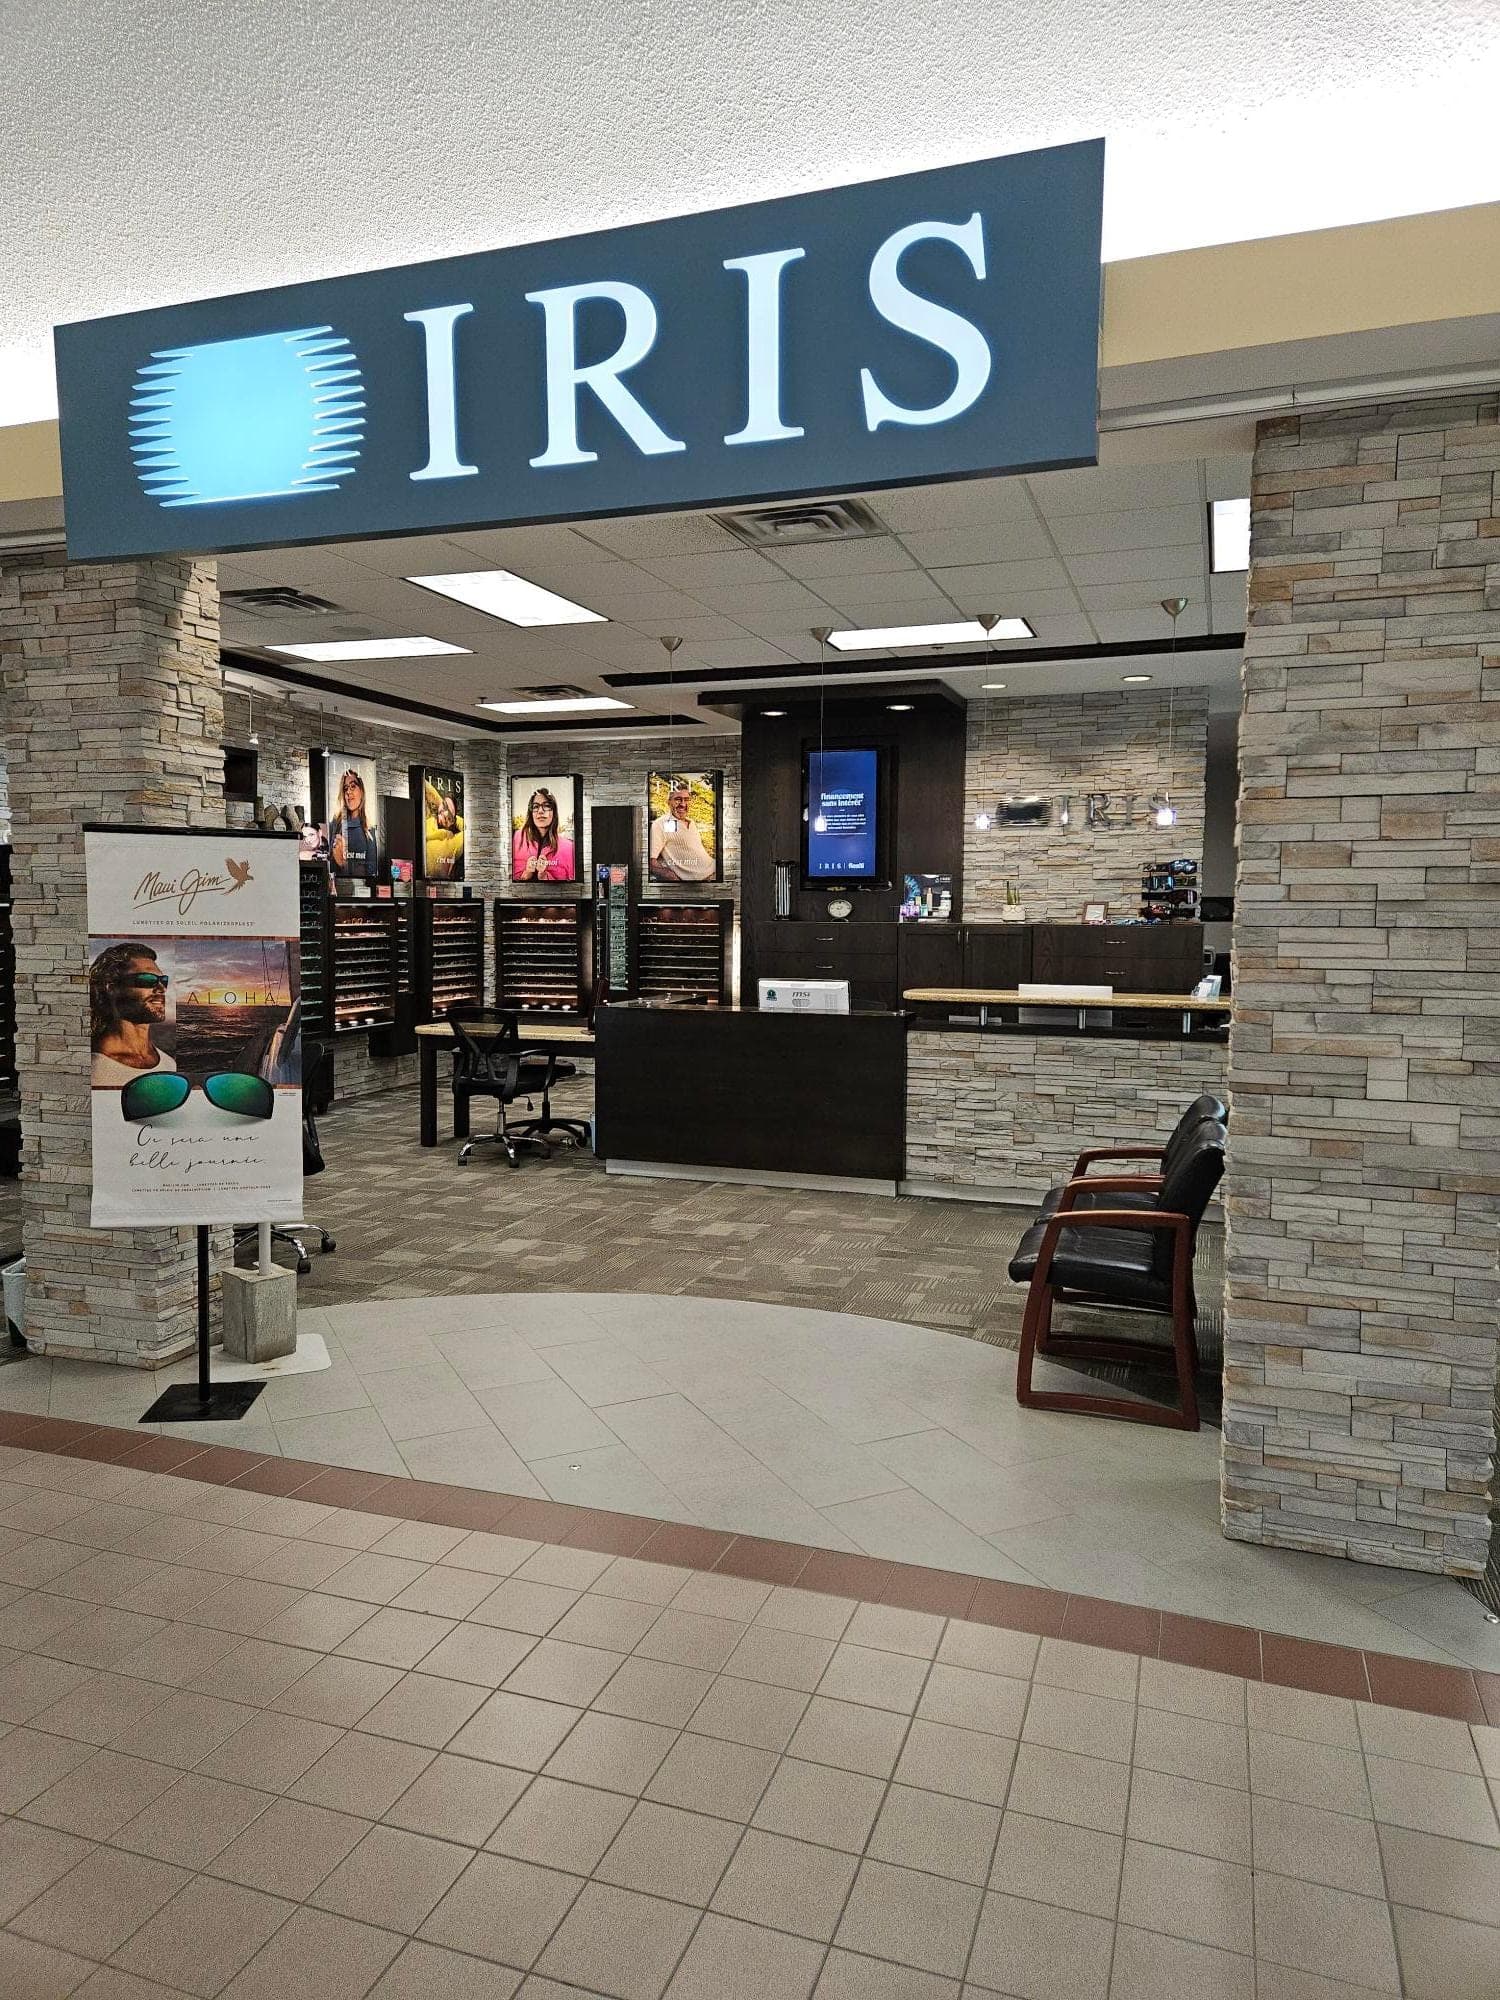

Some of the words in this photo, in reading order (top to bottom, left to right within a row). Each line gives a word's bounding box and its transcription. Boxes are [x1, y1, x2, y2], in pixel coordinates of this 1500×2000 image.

[403, 211, 992, 481] IRIS
[427, 775, 461, 794] IRIS
[133, 871, 177, 901] Maui
[178, 868, 222, 916] Jim
[187, 991, 276, 1005] ALOHA
[136, 1123, 161, 1147] Ce
[129, 1150, 179, 1170] belle
